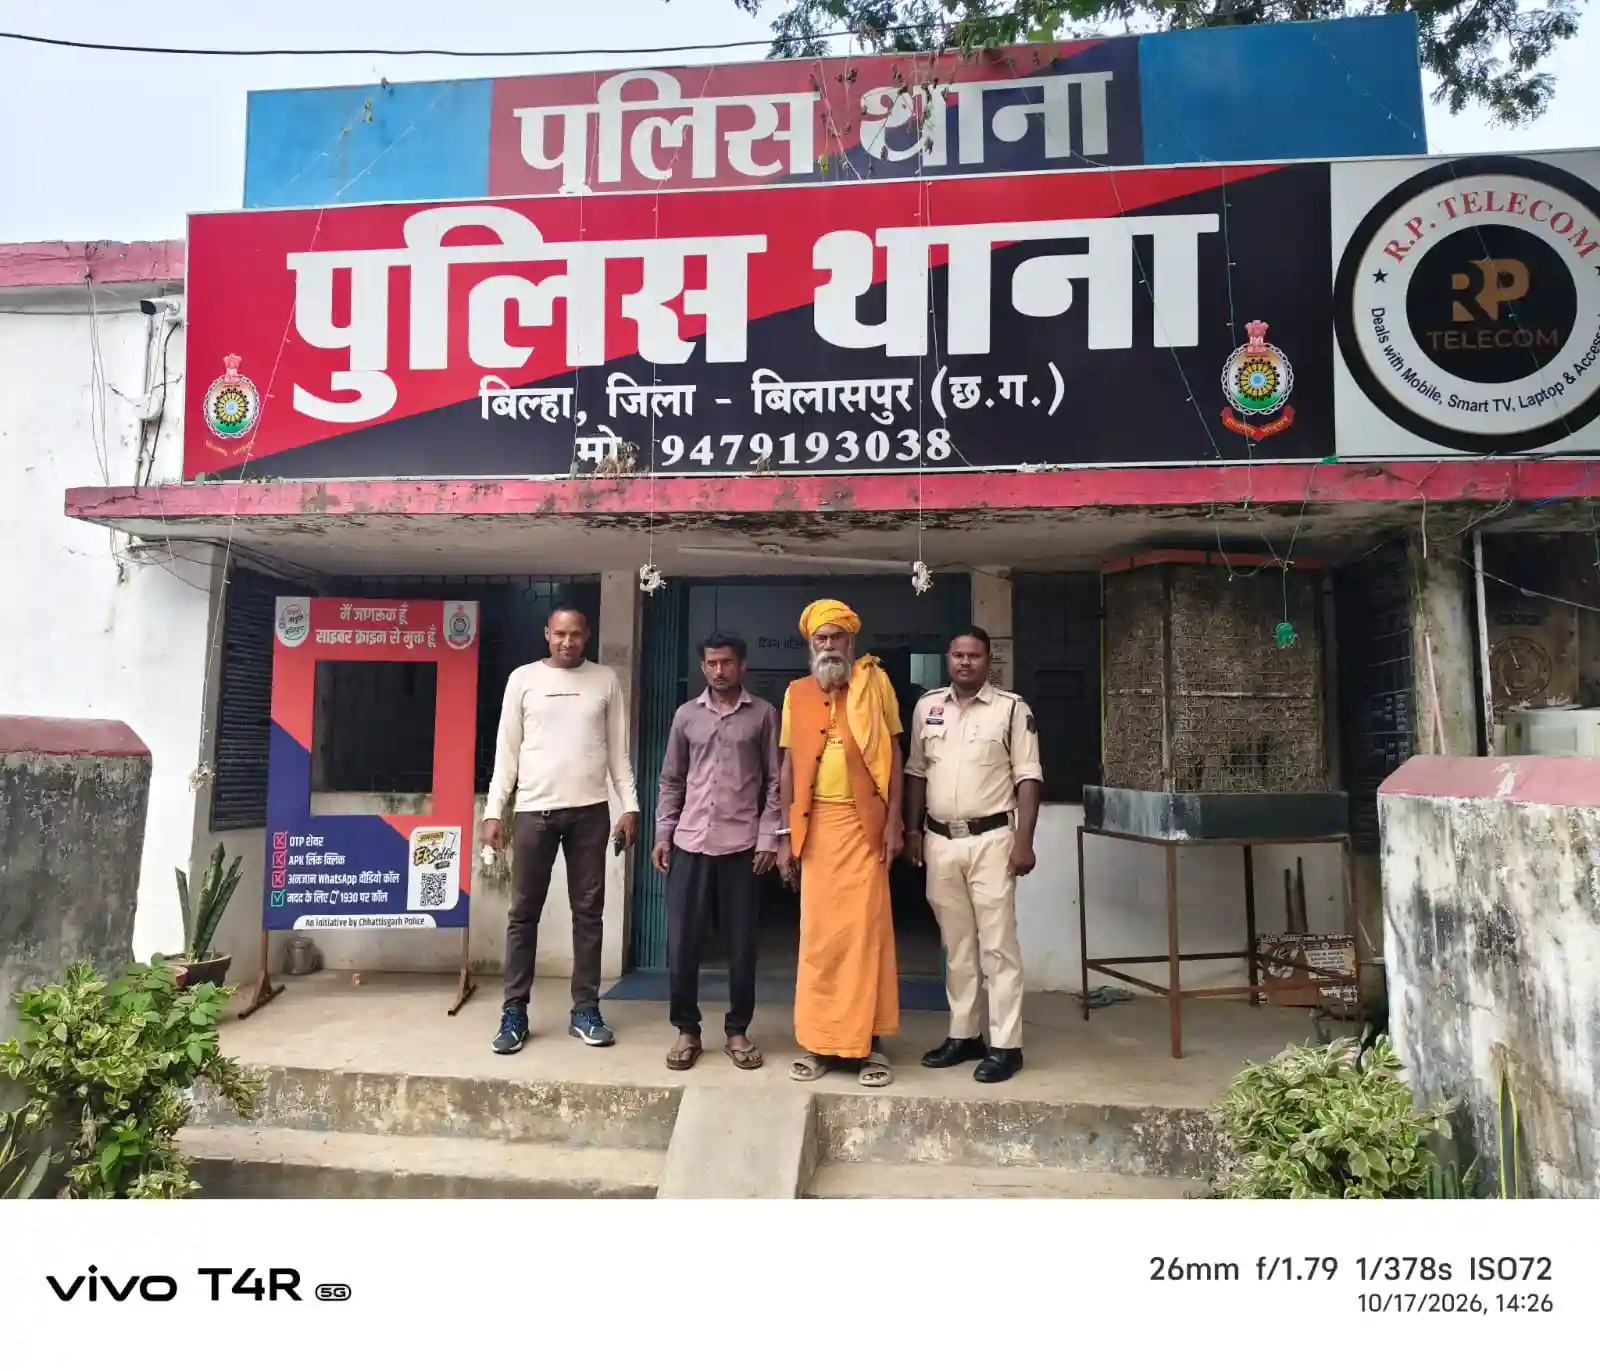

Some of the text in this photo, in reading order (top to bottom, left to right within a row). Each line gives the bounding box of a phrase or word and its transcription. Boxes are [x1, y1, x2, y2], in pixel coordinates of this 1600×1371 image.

[860, 71, 1114, 168] थाना
[1383, 190, 1600, 263] R.P. TELECOM
[1452, 258, 1530, 322] RP
[286, 205, 1220, 423] पुलिस थाना
[1427, 328, 1558, 350] TELECOM
[1371, 307, 1390, 344] Deals
[1383, 344, 1405, 372] with
[1401, 368, 1443, 405] Mobile,
[1448, 394, 1489, 413] Smart
[1492, 399, 1516, 412] TV,
[1518, 380, 1565, 408] Laptop
[1562, 372, 1577, 385] &
[480, 375, 587, 427] बिल्हा,
[606, 372, 696, 419] जिला
[752, 368, 913, 425] बिलासपुर
[931, 362, 1065, 417] (छ.ग.)
[661, 428, 952, 466] 9479193038
[353, 607, 397, 621] जागरूक
[315, 629, 353, 645] साइबर
[389, 626, 401, 645] से
[402, 630, 425, 649] मुक्त
[289, 836, 304, 847] OTP
[288, 855, 304, 866] APK
[288, 873, 317, 885] अनजान
[318, 873, 358, 886] WhatsApp
[286, 892, 303, 903] मदद
[304, 890, 312, 903] के
[313, 890, 329, 903] लिए
[340, 892, 358, 903] 1930
[359, 892, 370, 903] पर
[305, 918, 313, 926] An
[349, 917, 357, 928] by
[359, 917, 403, 928] Chhattisgarh
[404, 916, 425, 926] Police
